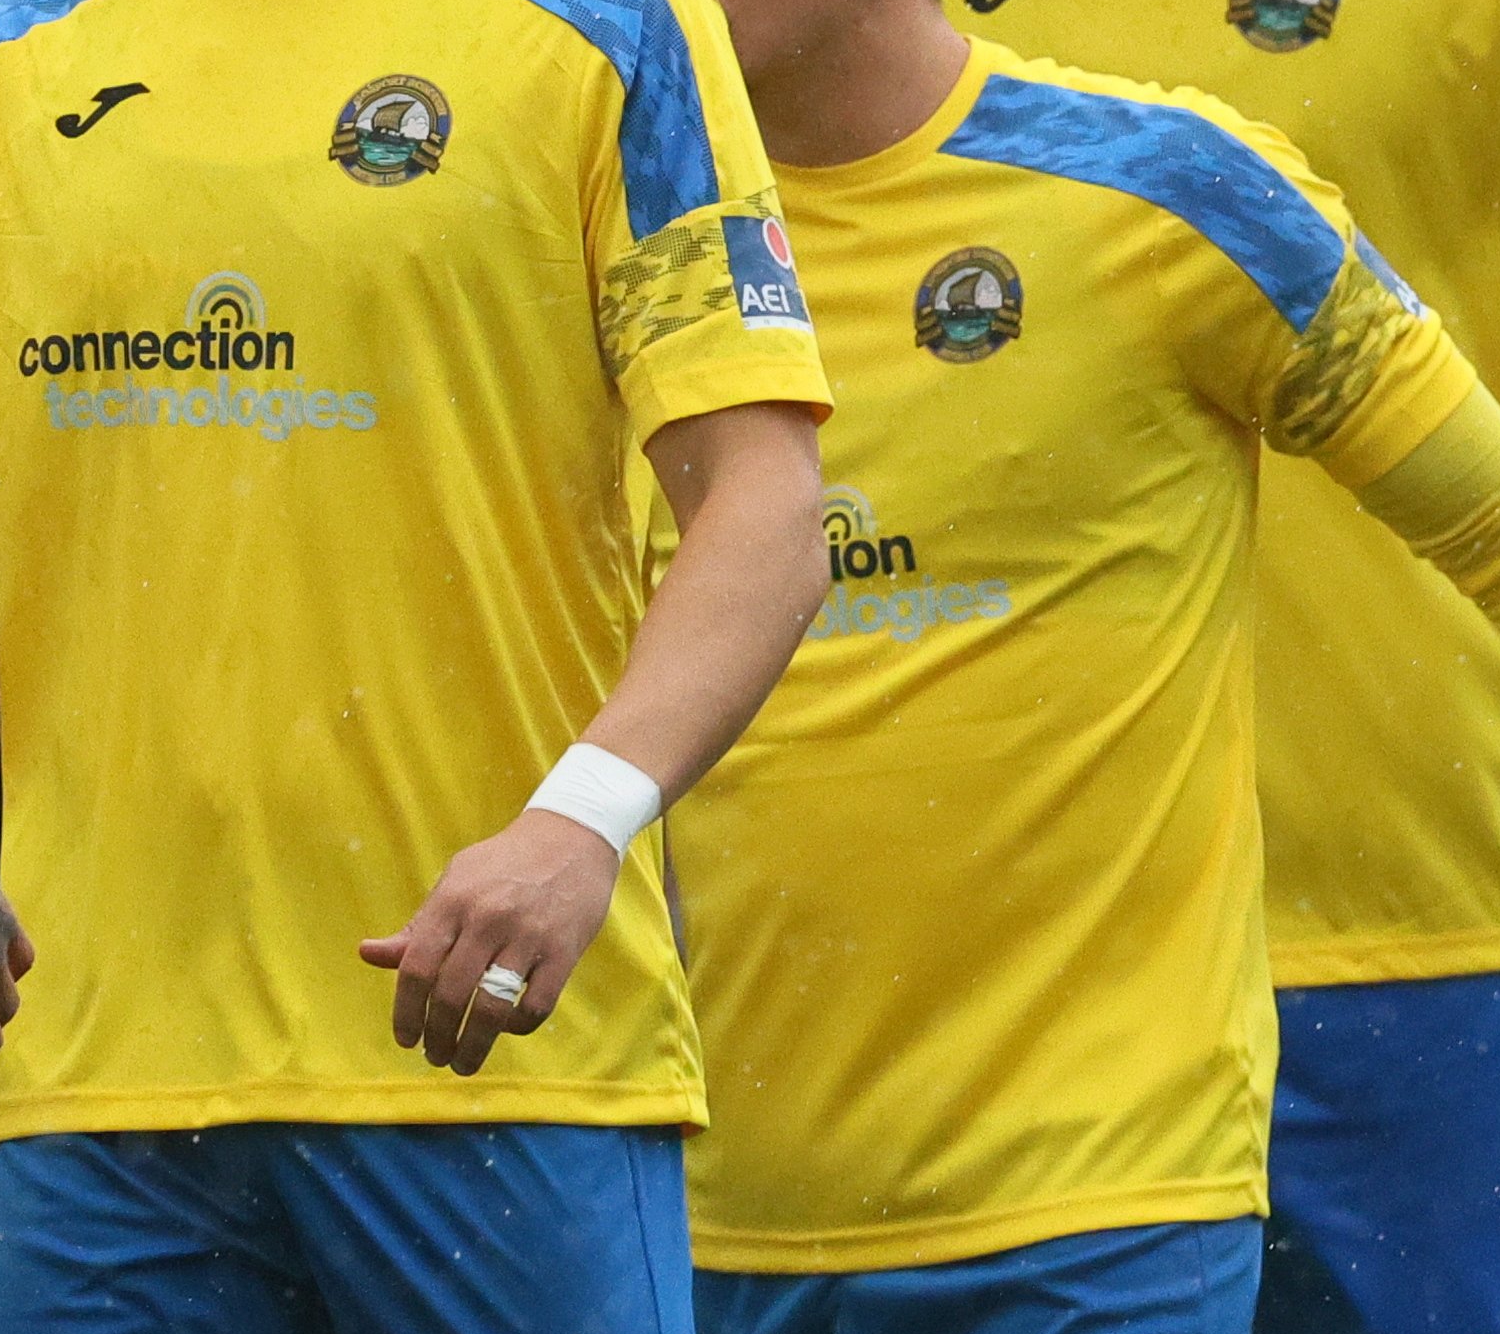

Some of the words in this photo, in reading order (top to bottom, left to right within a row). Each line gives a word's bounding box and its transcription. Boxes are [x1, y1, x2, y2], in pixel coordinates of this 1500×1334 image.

[741, 283, 792, 314] AEI
[19, 317, 295, 377] connection
[44, 375, 379, 441] technologies
